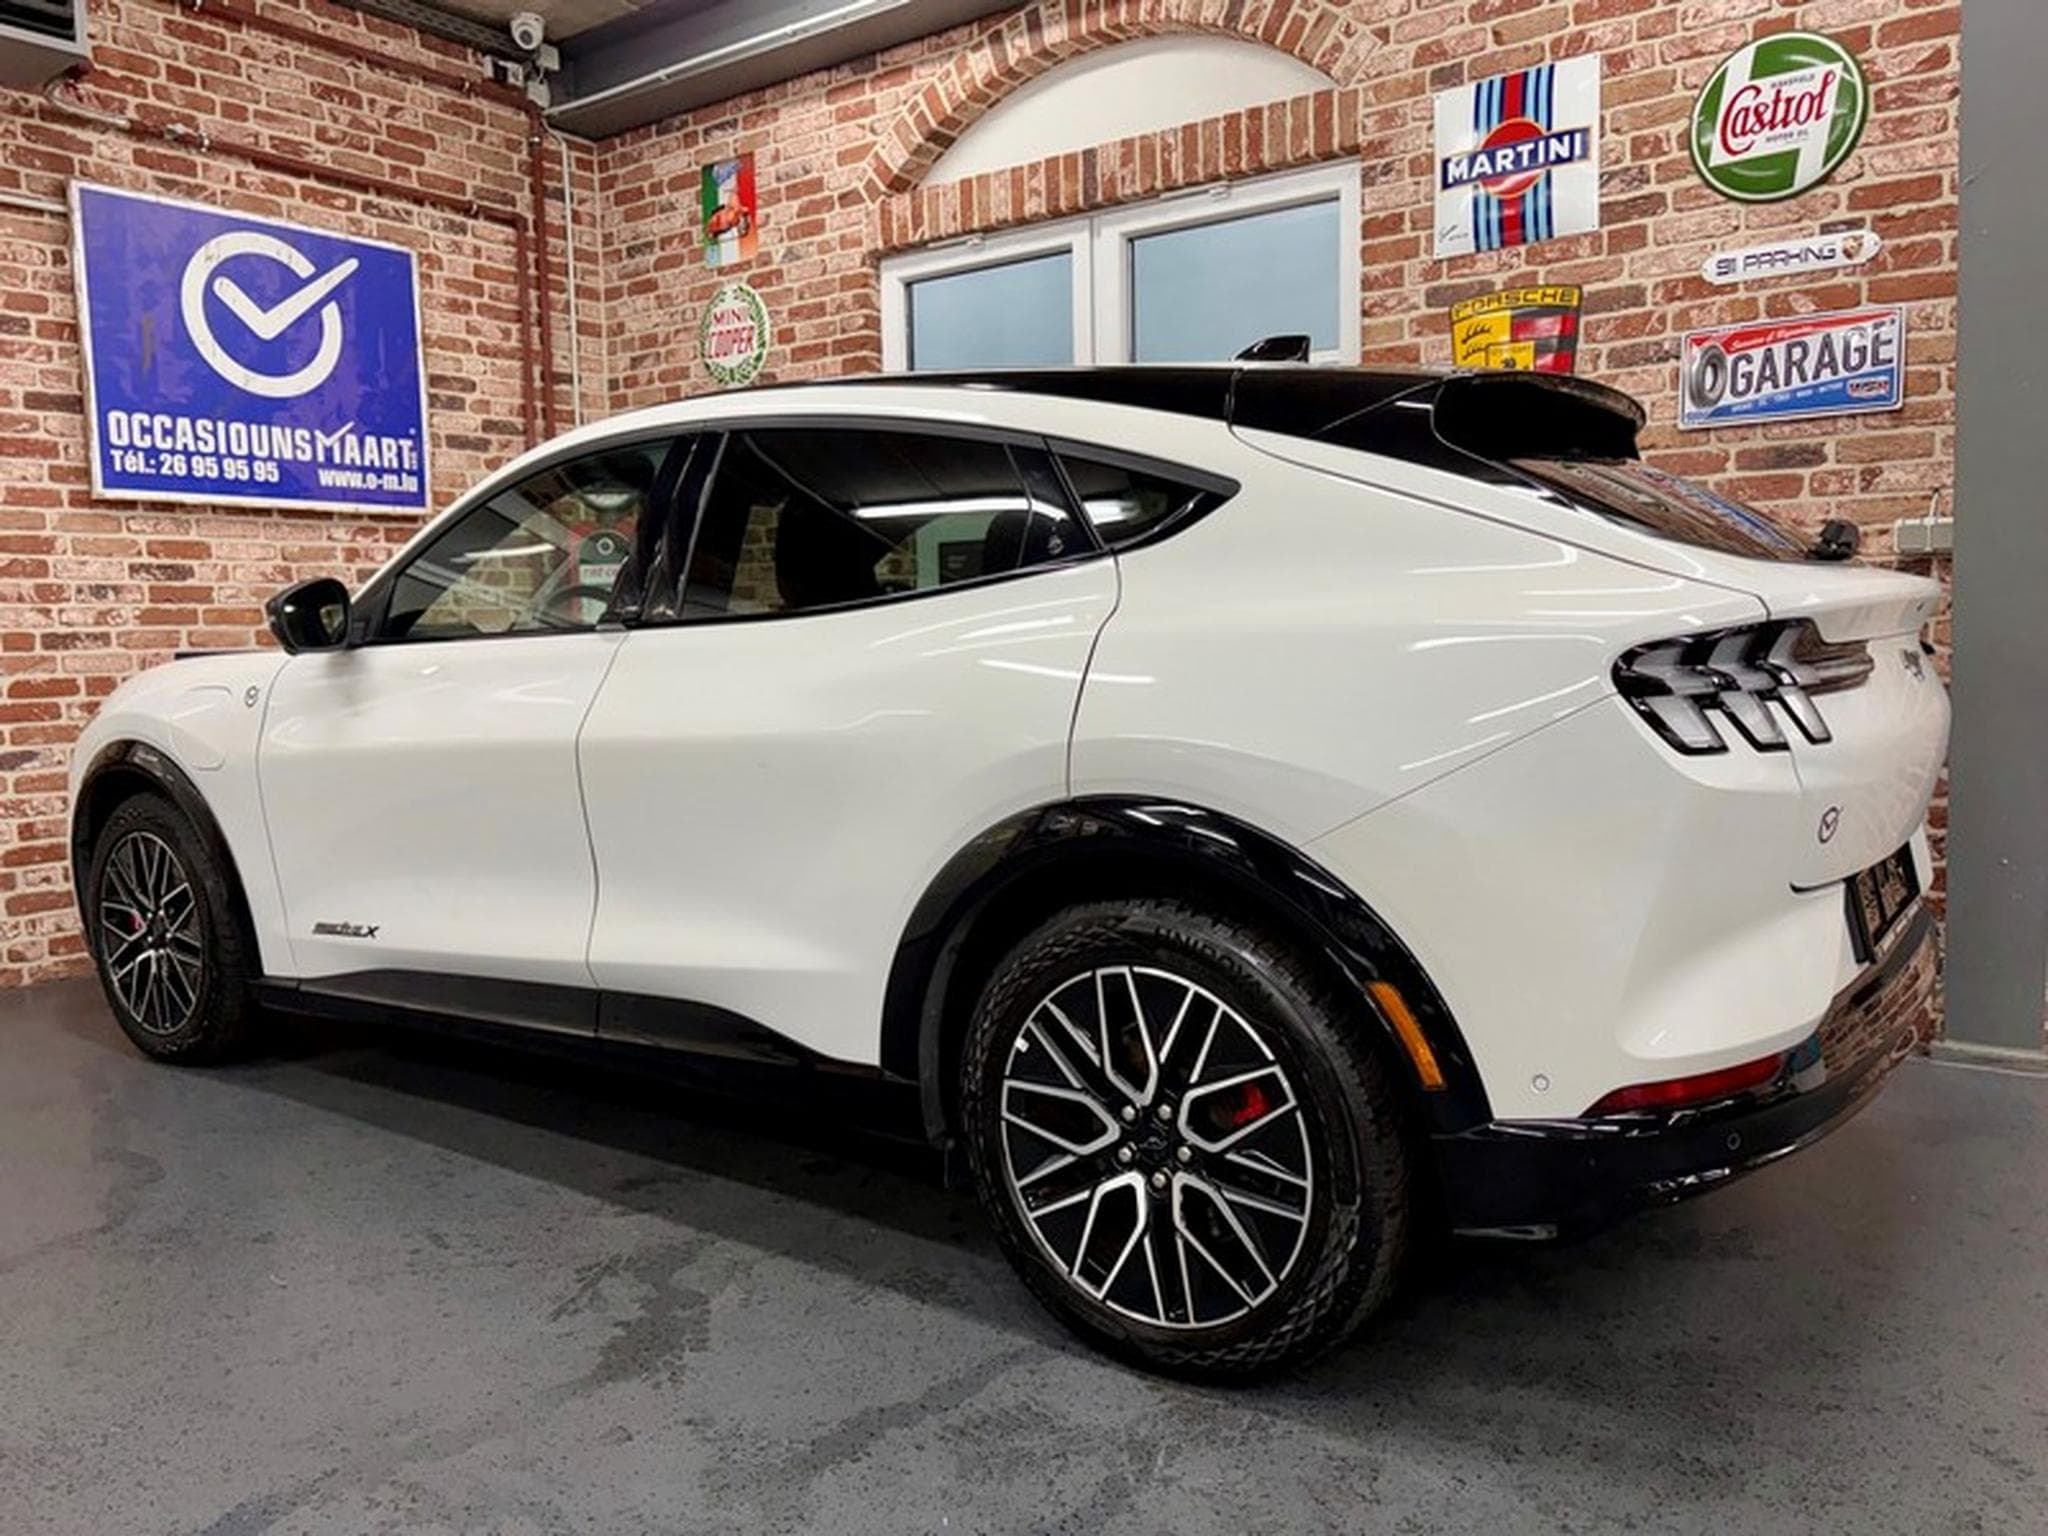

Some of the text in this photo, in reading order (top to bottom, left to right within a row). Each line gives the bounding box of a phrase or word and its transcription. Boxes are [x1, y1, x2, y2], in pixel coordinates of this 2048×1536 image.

[1720, 69, 1837, 158] Castrol
[1447, 132, 1583, 185] MARTINI
[1743, 243, 1836, 272] PARKING
[1454, 286, 1576, 318] PORSCHE
[1729, 319, 1895, 398] GARAGE
[110, 449, 280, 483] Tél.: 26 95 95 95
[318, 467, 418, 492] www.o-m.lu
